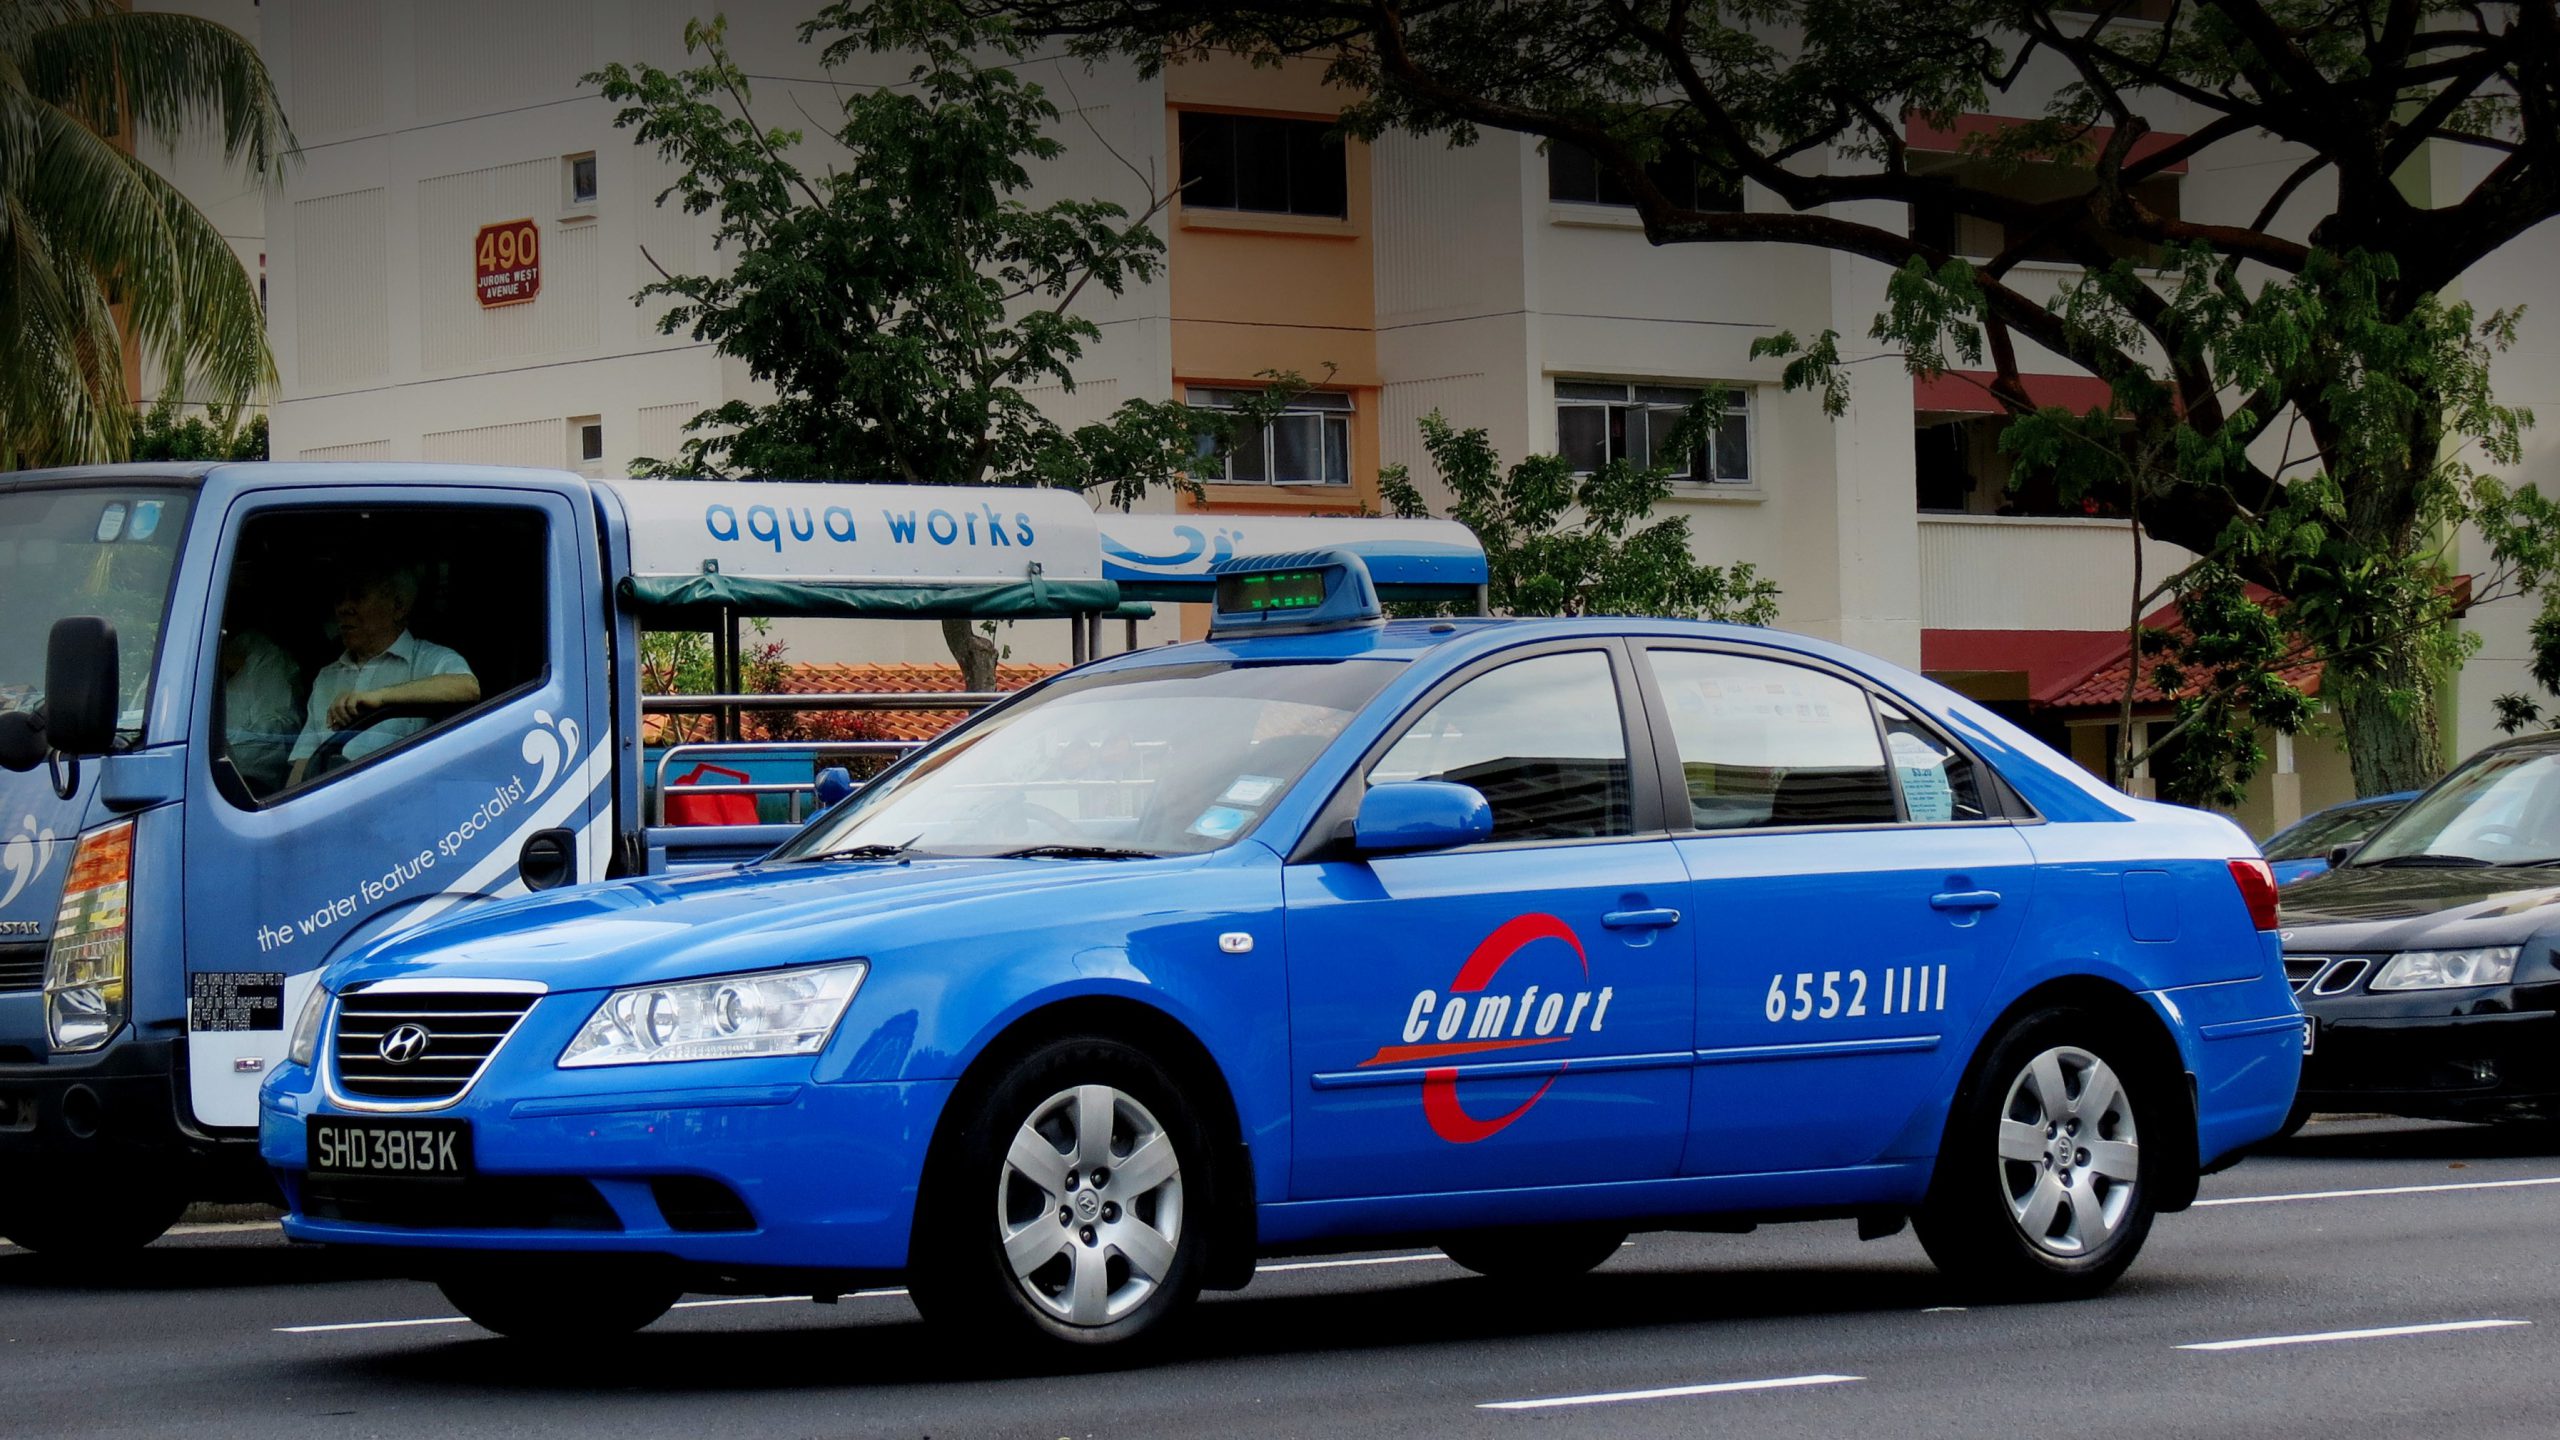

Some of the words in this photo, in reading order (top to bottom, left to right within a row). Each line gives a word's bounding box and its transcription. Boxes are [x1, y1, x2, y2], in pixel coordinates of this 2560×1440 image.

[480, 227, 536, 271] 490
[478, 272, 511, 288] JURONG
[514, 267, 538, 282] WEST
[487, 283, 519, 298] AVENUE
[525, 281, 530, 292] 1
[706, 503, 856, 553] aqua
[882, 502, 1034, 547] works
[257, 924, 294, 952] the
[298, 893, 357, 936] water
[360, 849, 435, 905] feature
[438, 775, 525, 856] specialist
[0, 921, 40, 934] STAR
[1402, 985, 1613, 1043] Comfort
[1765, 969, 1867, 1022] 6552
[1882, 964, 1947, 1015] 1111
